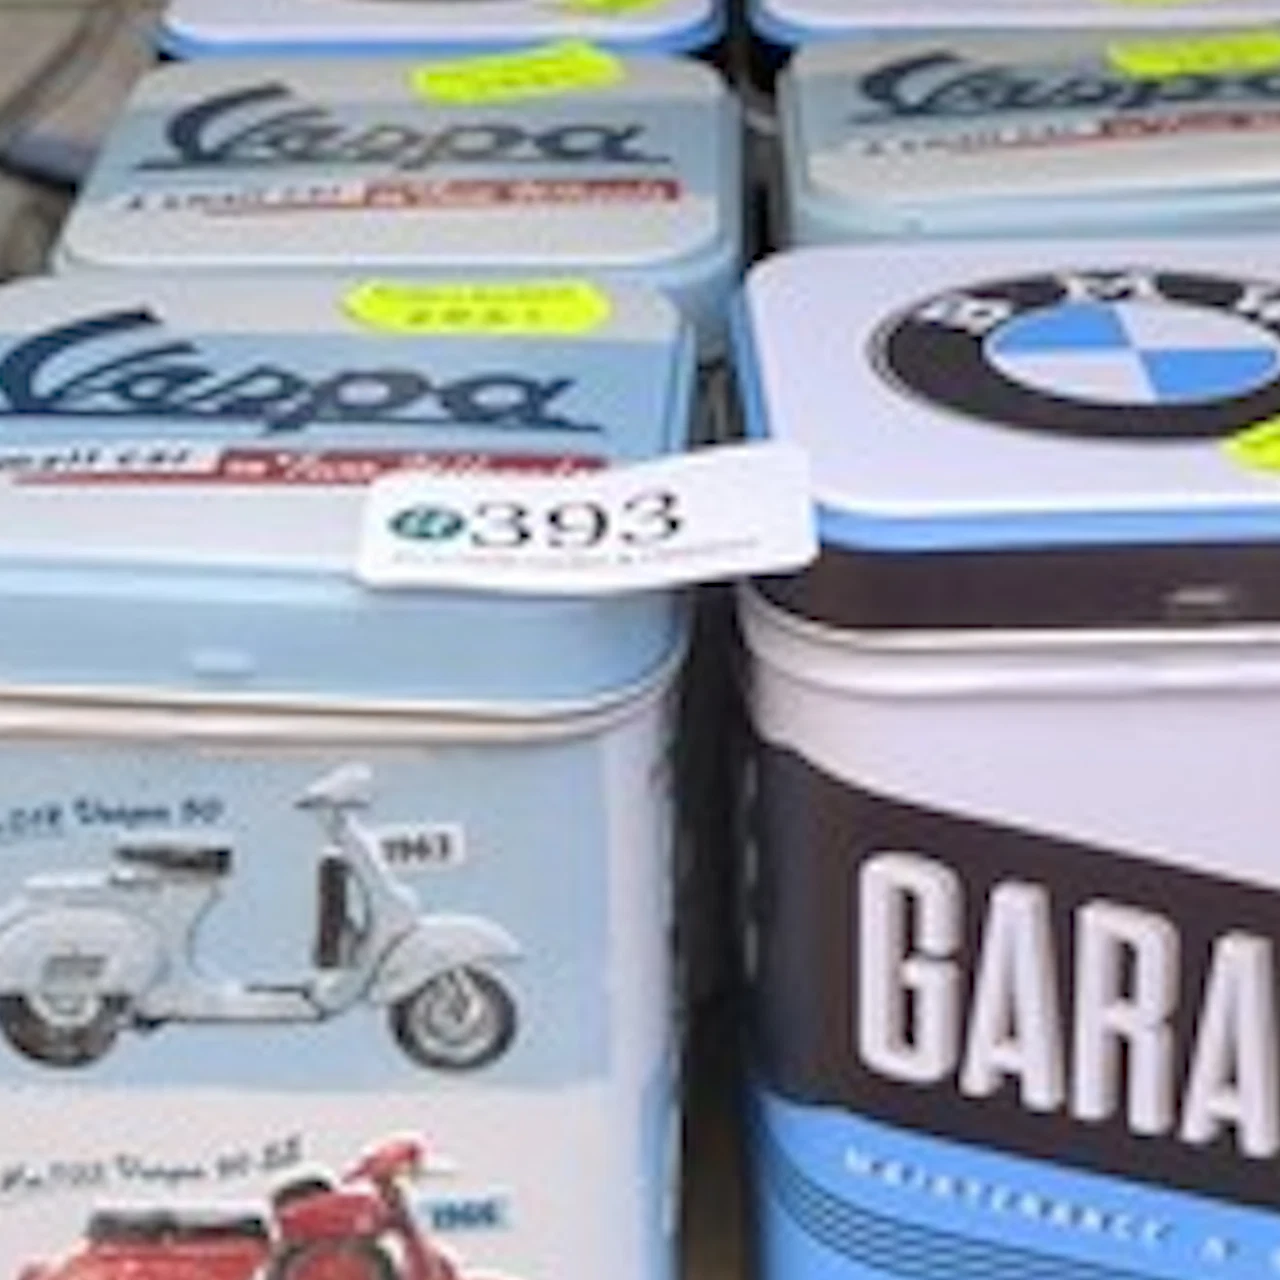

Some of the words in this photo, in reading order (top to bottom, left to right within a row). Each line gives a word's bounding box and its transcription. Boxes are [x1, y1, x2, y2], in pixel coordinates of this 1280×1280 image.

[132, 81, 672, 170] Vespa
[470, 490, 684, 549] 393
[842, 1146, 1173, 1245] MAINTENANCE
